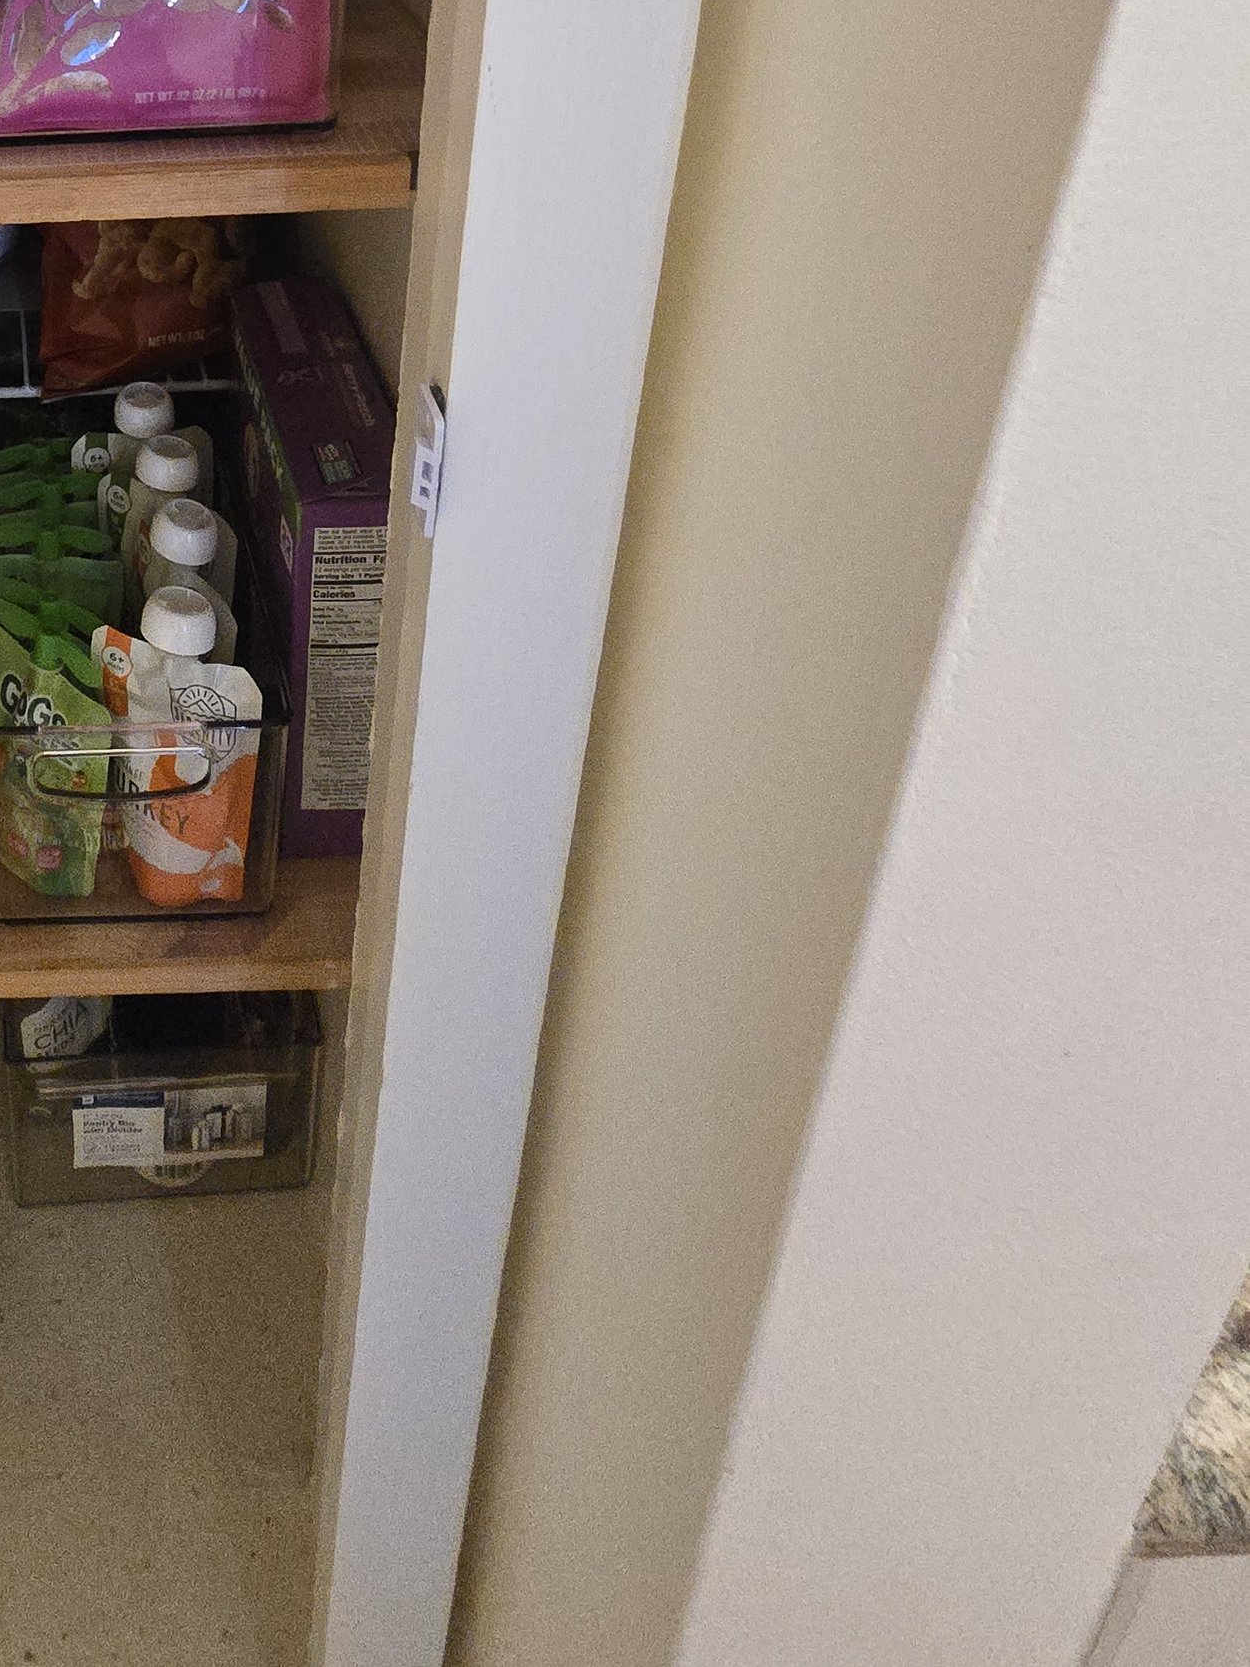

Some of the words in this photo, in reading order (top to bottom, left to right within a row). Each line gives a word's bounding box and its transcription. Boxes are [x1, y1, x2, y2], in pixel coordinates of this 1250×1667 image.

[315, 555, 367, 565] Nutrition
[313, 589, 356, 599] Calories
[109, 652, 124, 665] 6+
